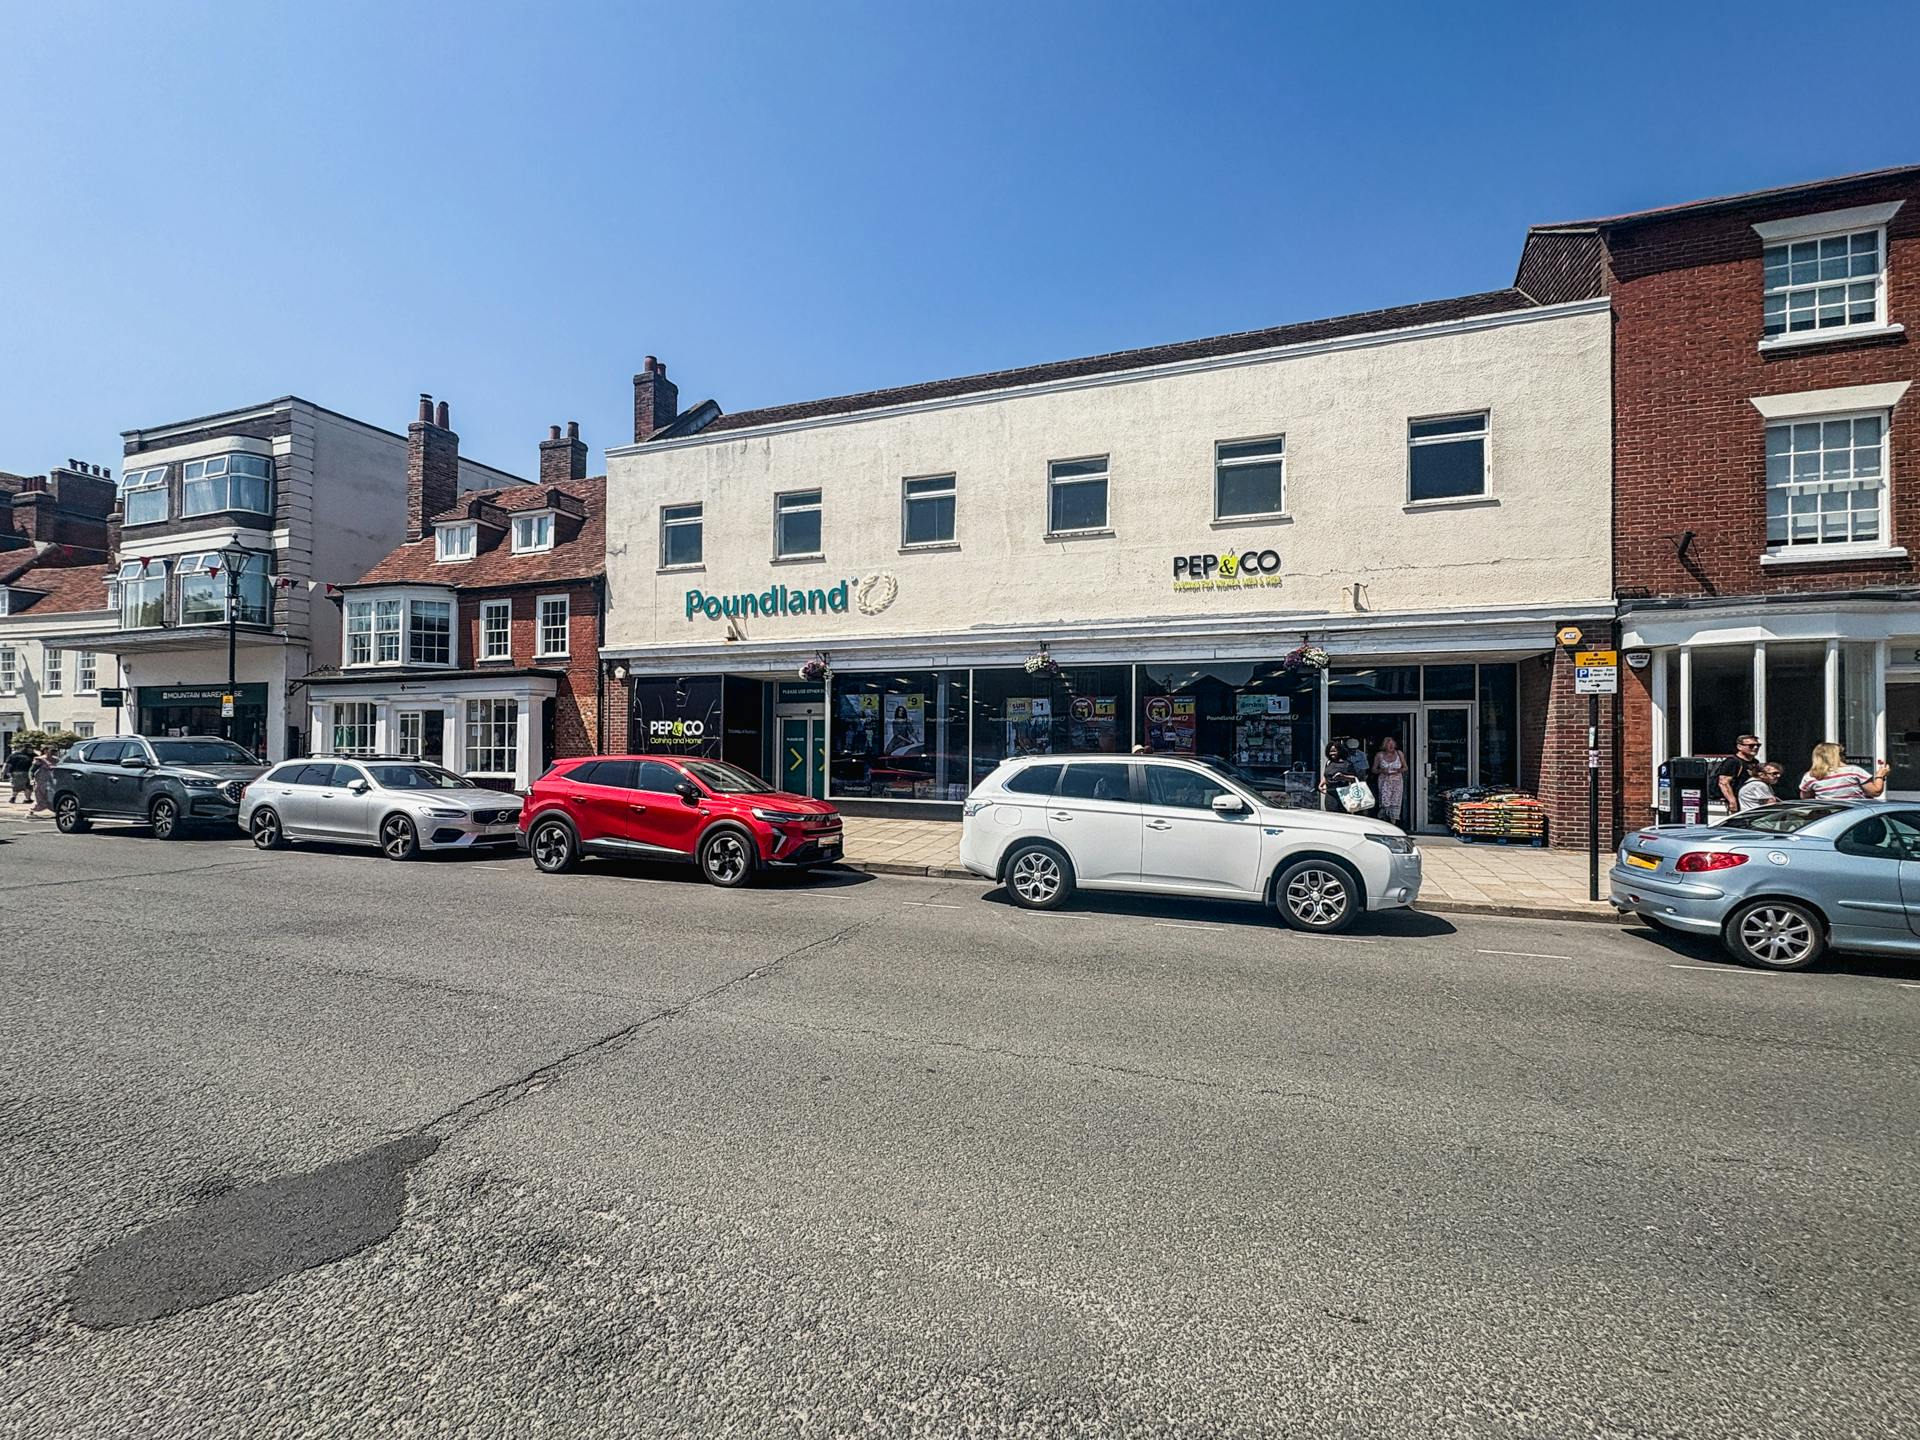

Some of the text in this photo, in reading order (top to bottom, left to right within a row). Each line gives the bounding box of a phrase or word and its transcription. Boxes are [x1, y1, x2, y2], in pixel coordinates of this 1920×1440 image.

[1173, 549, 1281, 578] PEP&CO
[685, 580, 849, 620] Poundland
[1580, 669, 1587, 677] P
[650, 719, 704, 736] PEP&CO
